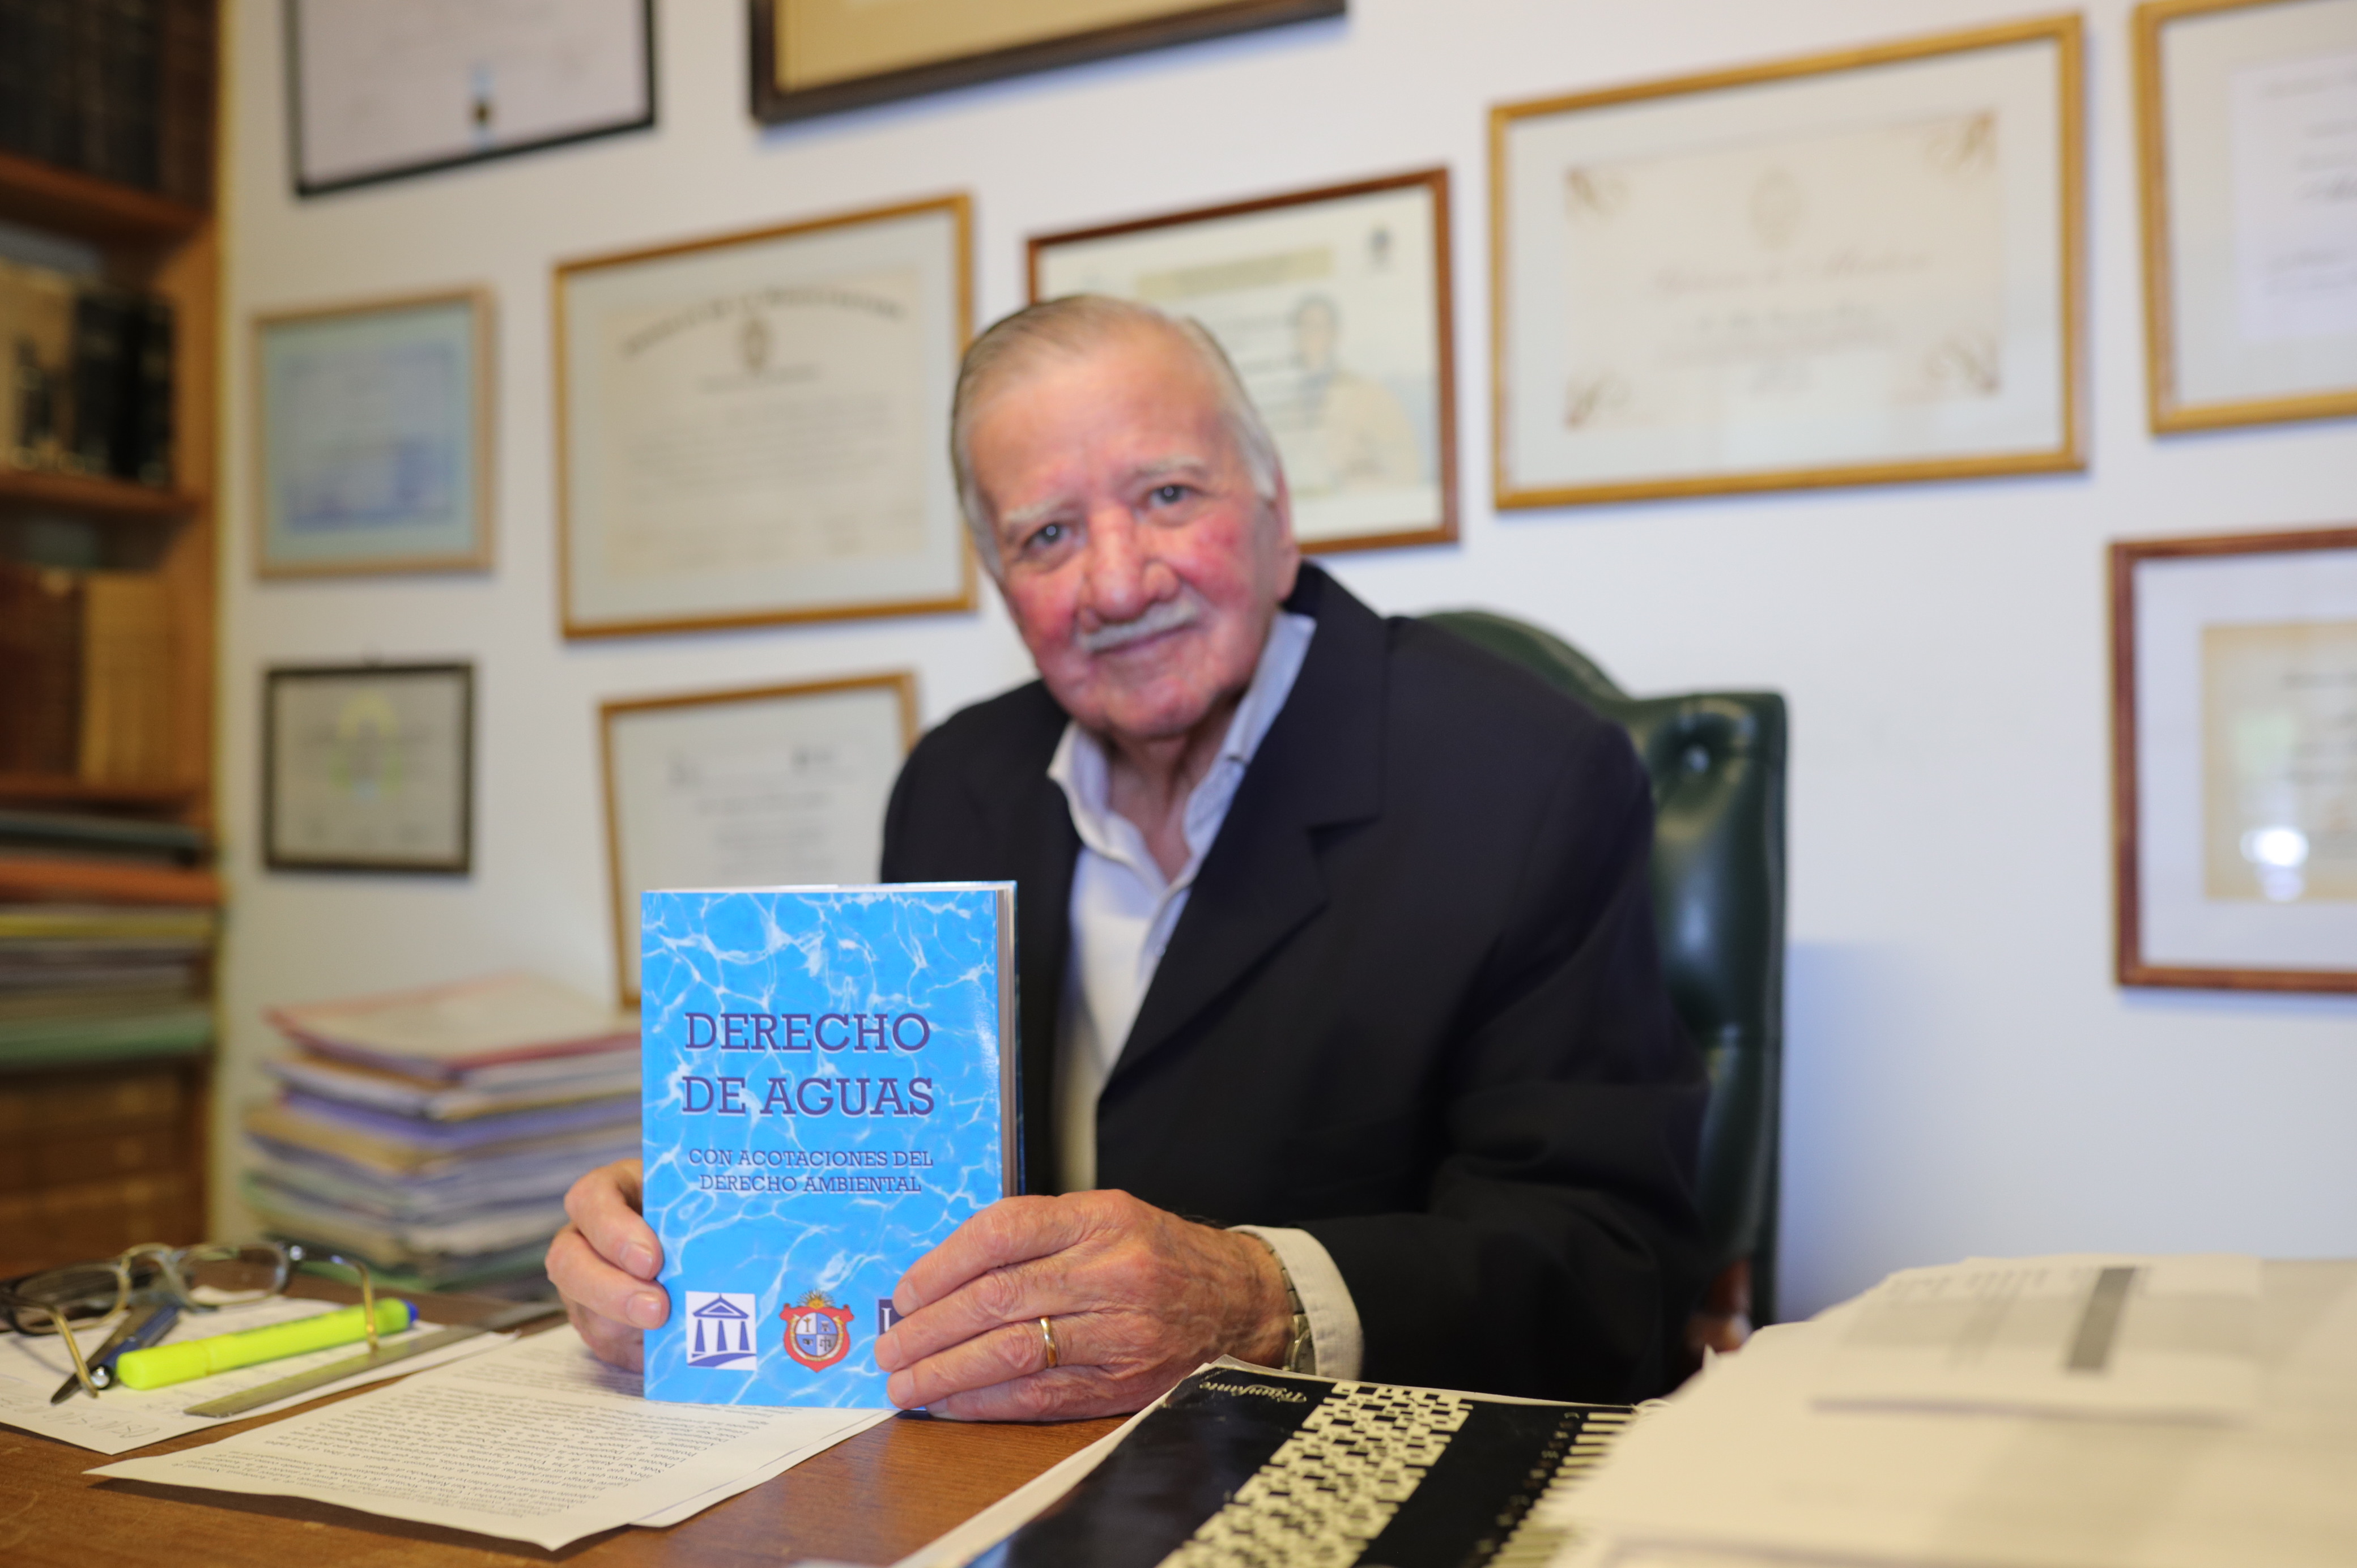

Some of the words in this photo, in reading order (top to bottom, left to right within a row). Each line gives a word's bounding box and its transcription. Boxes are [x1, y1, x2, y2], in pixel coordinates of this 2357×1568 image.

[684, 1012, 931, 1053] DERECHO
[682, 1076, 746, 1115] DE
[760, 1077, 934, 1117] AGUAS
[689, 1149, 733, 1166] CON
[739, 1150, 888, 1168] ACOTACIONES
[892, 1151, 934, 1168] DEL
[699, 1174, 797, 1192] DERECHO
[803, 1176, 922, 1194] AMBIENTAL
